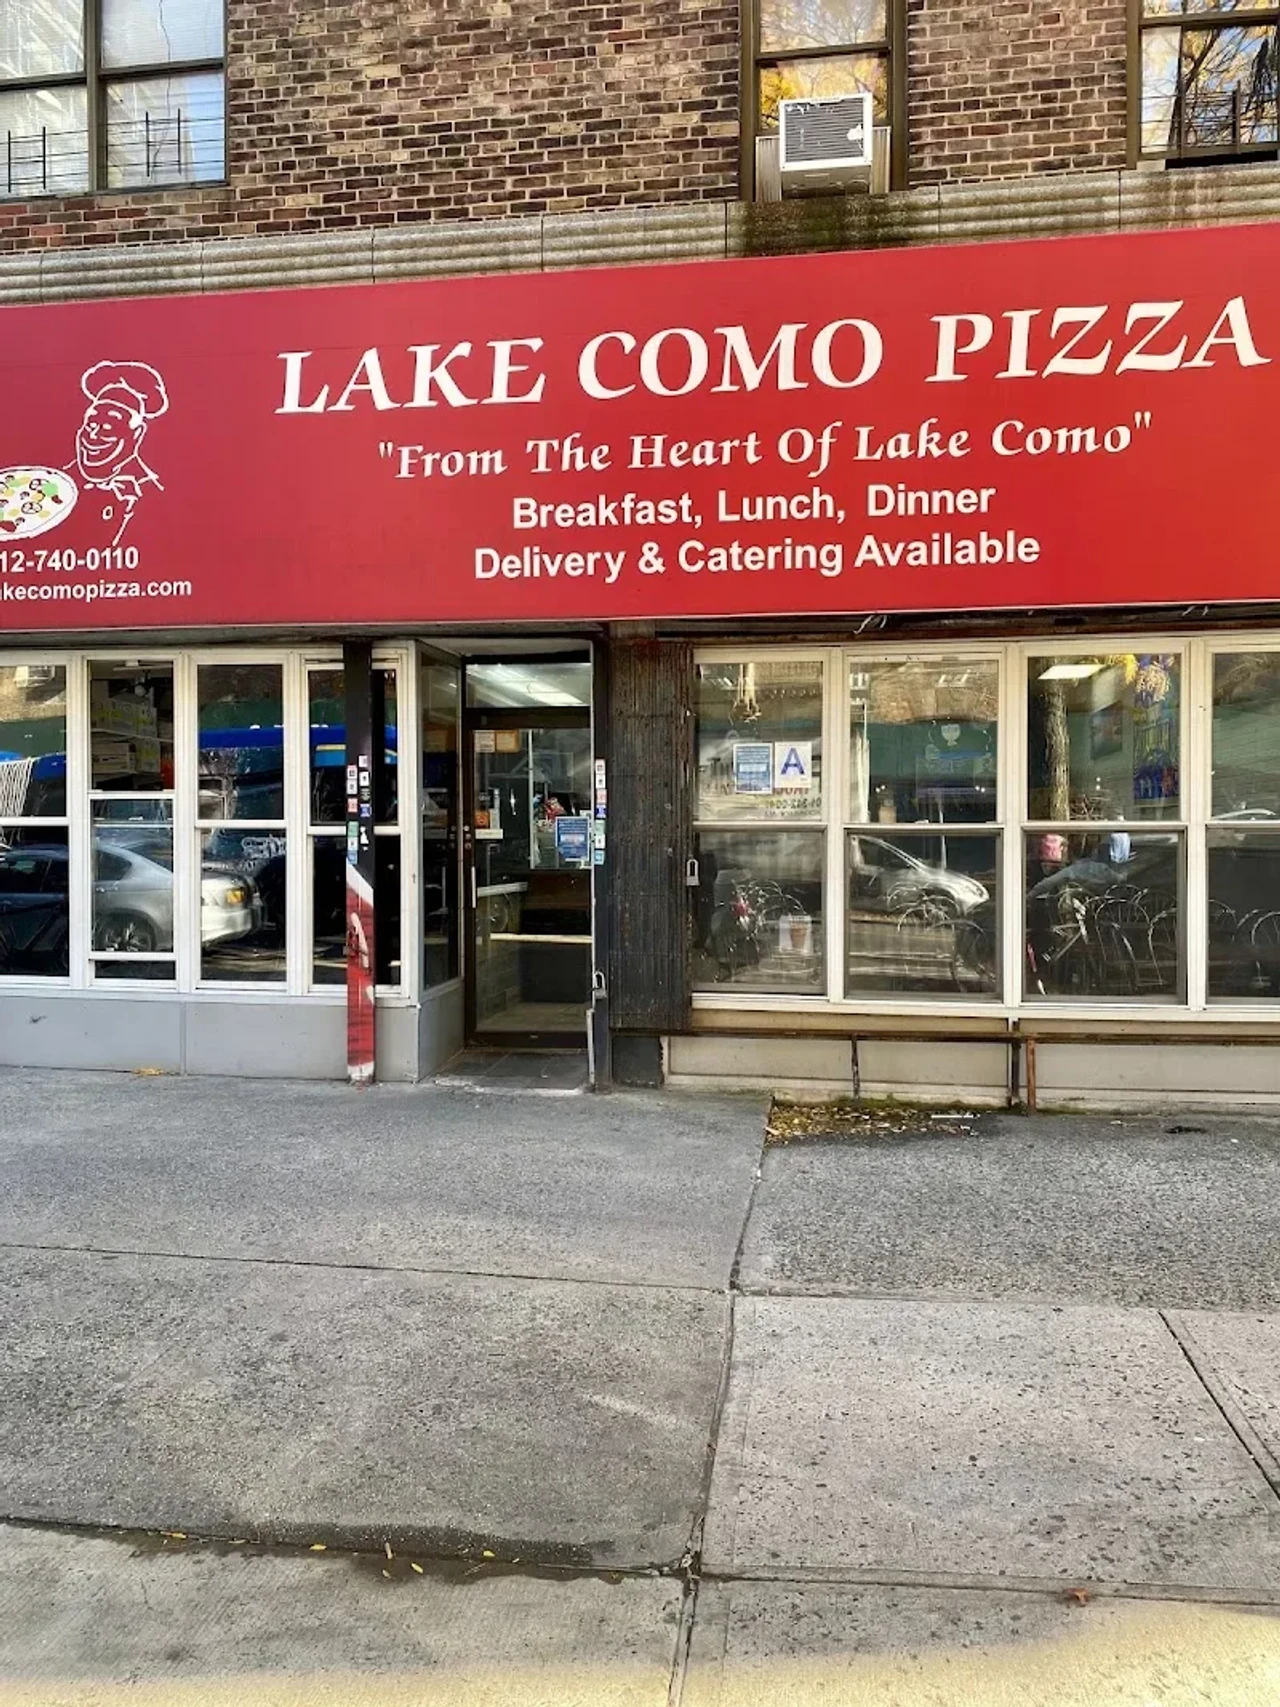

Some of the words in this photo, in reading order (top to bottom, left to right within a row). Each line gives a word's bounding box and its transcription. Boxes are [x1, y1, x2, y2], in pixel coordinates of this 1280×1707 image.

[274, 337, 546, 415] LAKE
[578, 318, 883, 399] COMO
[924, 295, 1273, 383] PIZZA
[379, 440, 508, 480] "From
[526, 432, 612, 473] The
[627, 432, 763, 469] Heart
[778, 421, 843, 478] Of
[853, 417, 971, 463] Lake
[992, 410, 1152, 456] Como"
[513, 492, 702, 529] Breakfast,
[718, 486, 845, 524] Lunch,
[868, 483, 996, 517] Dinner
[0, 546, 139, 574] 12-740-0110
[475, 546, 626, 584] Delivery
[638, 541, 666, 574] &
[678, 537, 843, 577] Catering
[854, 530, 1040, 568] Available
[781, 747, 805, 775] A
